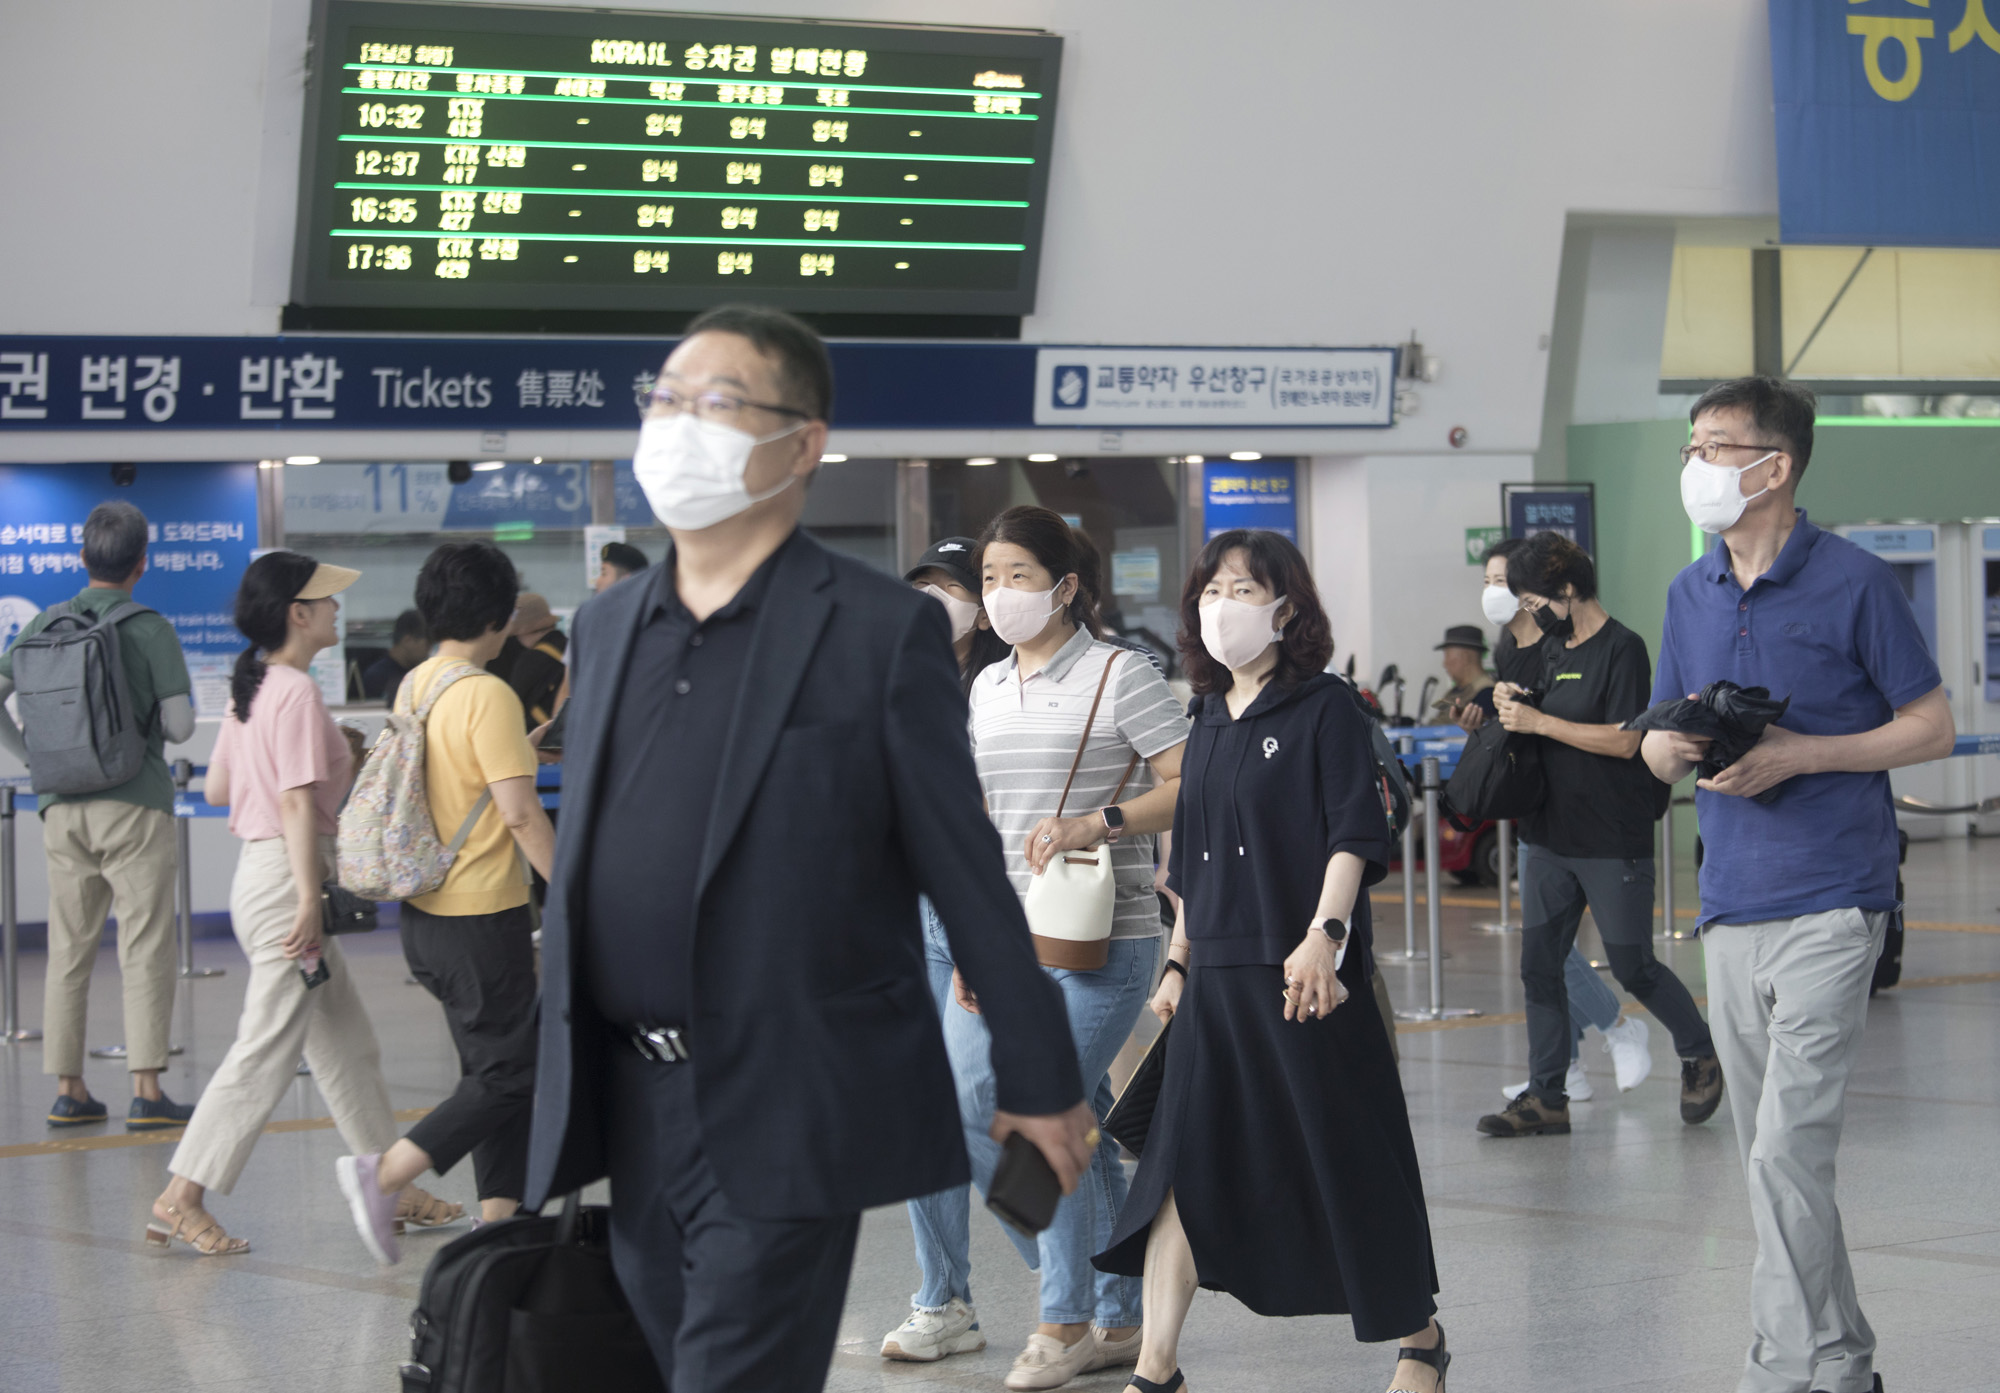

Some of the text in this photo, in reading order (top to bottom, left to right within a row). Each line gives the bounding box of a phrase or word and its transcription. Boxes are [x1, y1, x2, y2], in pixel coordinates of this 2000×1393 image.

[591, 40, 867, 77] KORAIL 승차권 발매현황
[358, 103, 425, 129] 10:32
[448, 98, 485, 119] KTX
[447, 118, 482, 137] 413
[646, 114, 682, 136] 입석
[730, 117, 766, 139] 입석
[813, 120, 848, 142] 입석
[356, 150, 420, 176] 12:37
[444, 144, 480, 164] KTX
[443, 164, 477, 184] 417
[642, 159, 677, 182] 입석
[727, 162, 761, 184] 입석
[809, 165, 843, 187] 입석
[351, 197, 417, 223] 16:35
[440, 191, 477, 211] KTX
[438, 211, 474, 230] 427
[637, 205, 674, 227] 입석
[721, 207, 757, 229] 입석
[804, 209, 839, 231] 입석
[437, 238, 473, 258] KTX
[634, 250, 669, 273] 입석
[718, 252, 752, 274] 입석
[800, 254, 834, 276] 입석
[81, 356, 180, 422] 변경
[240, 353, 343, 419] 반환
[372, 367, 492, 408] Tickets
[517, 369, 605, 408] 售票处
[1097, 365, 1266, 394] 교통약자 우선창구
[163, 522, 244, 542] 도와드리니
[153, 553, 224, 572] 바랍니다.
